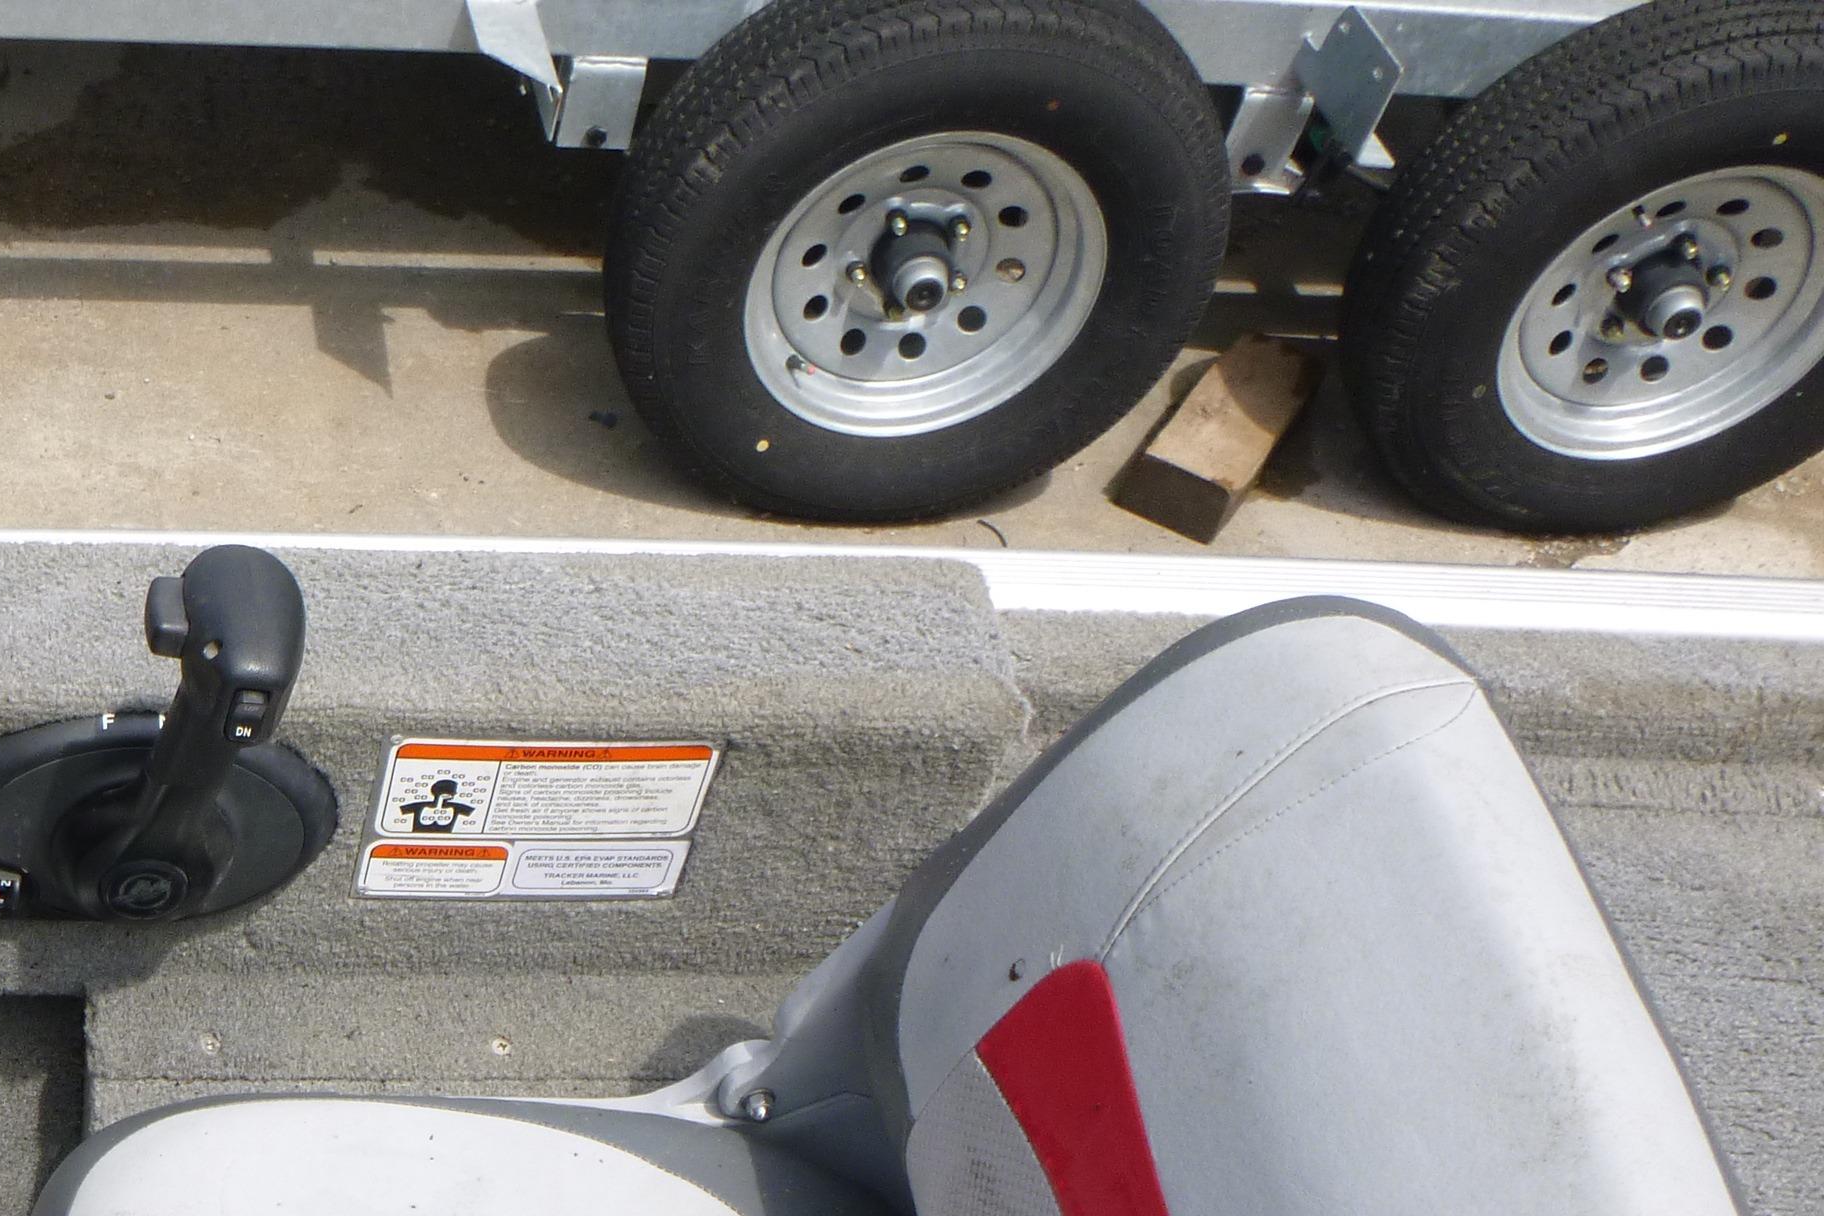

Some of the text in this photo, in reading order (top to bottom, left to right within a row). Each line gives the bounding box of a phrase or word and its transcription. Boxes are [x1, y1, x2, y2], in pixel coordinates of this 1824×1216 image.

[102, 714, 115, 730] F
[235, 726, 252, 738] DN
[522, 750, 596, 758] WARNING
[404, 848, 475, 856] WARNING
